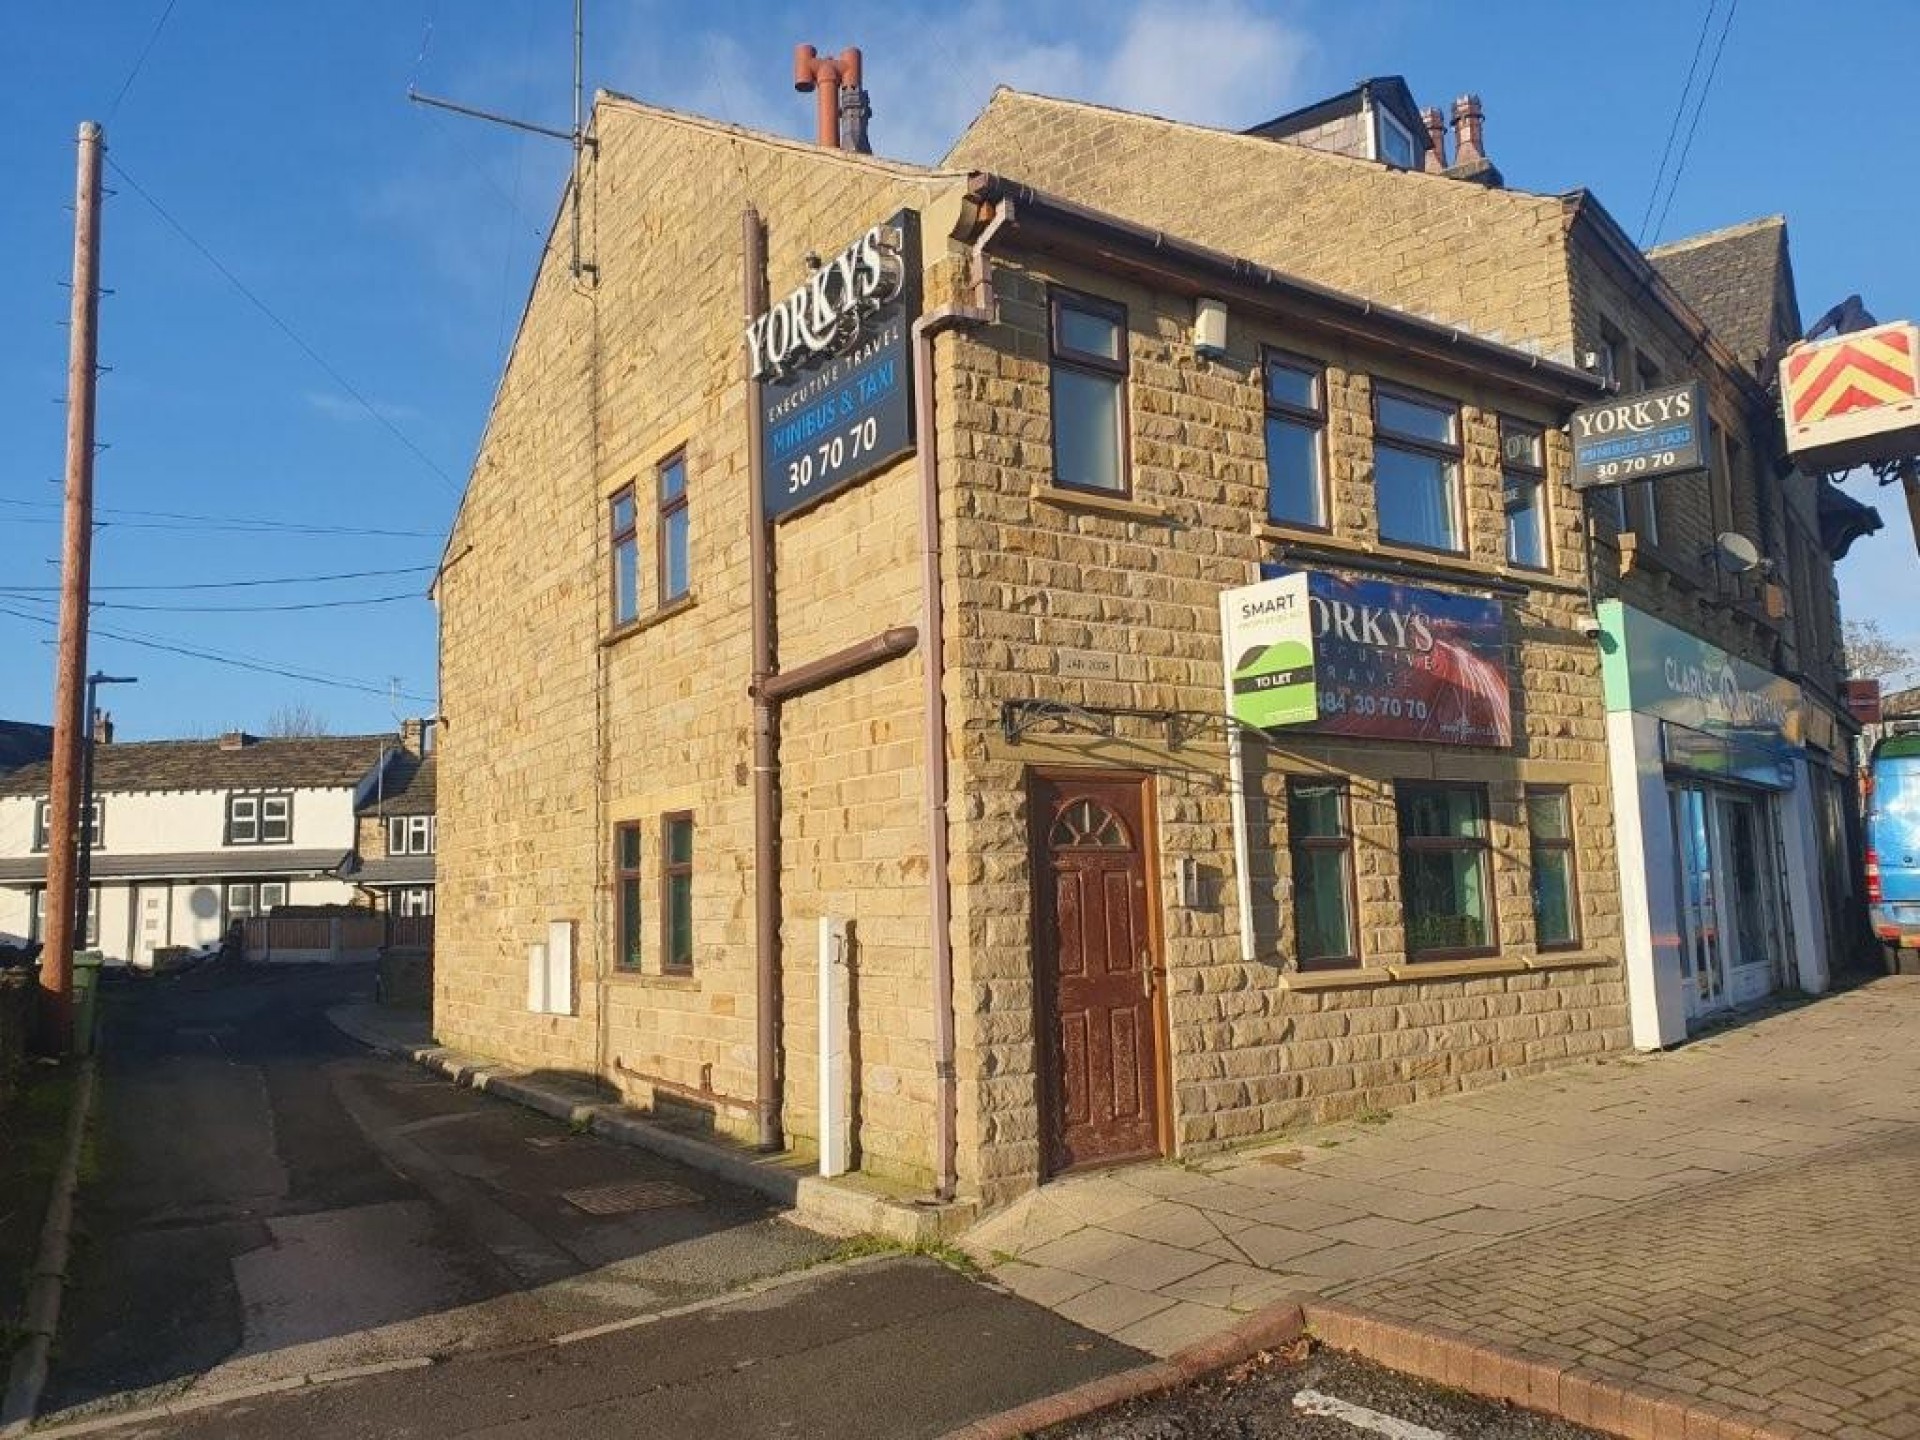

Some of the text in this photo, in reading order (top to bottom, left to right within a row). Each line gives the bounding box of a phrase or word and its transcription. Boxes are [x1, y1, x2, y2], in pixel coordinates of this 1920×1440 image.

[747, 226, 903, 379] YORKYS
[769, 326, 898, 423] EXECUTIVE TRAVEL
[773, 360, 894, 453] MINIBUS & TAXI
[1577, 391, 1691, 437] YORKYS
[789, 416, 876, 493] 30 70 70
[1597, 451, 1675, 479] 30 70 70
[1242, 593, 1295, 620] SMART
[1309, 596, 1433, 652] ORKYS
[1255, 672, 1293, 689] TO LET
[1354, 694, 1375, 716] 30
[1380, 696, 1401, 718] 70
[1406, 699, 1427, 719] 70
